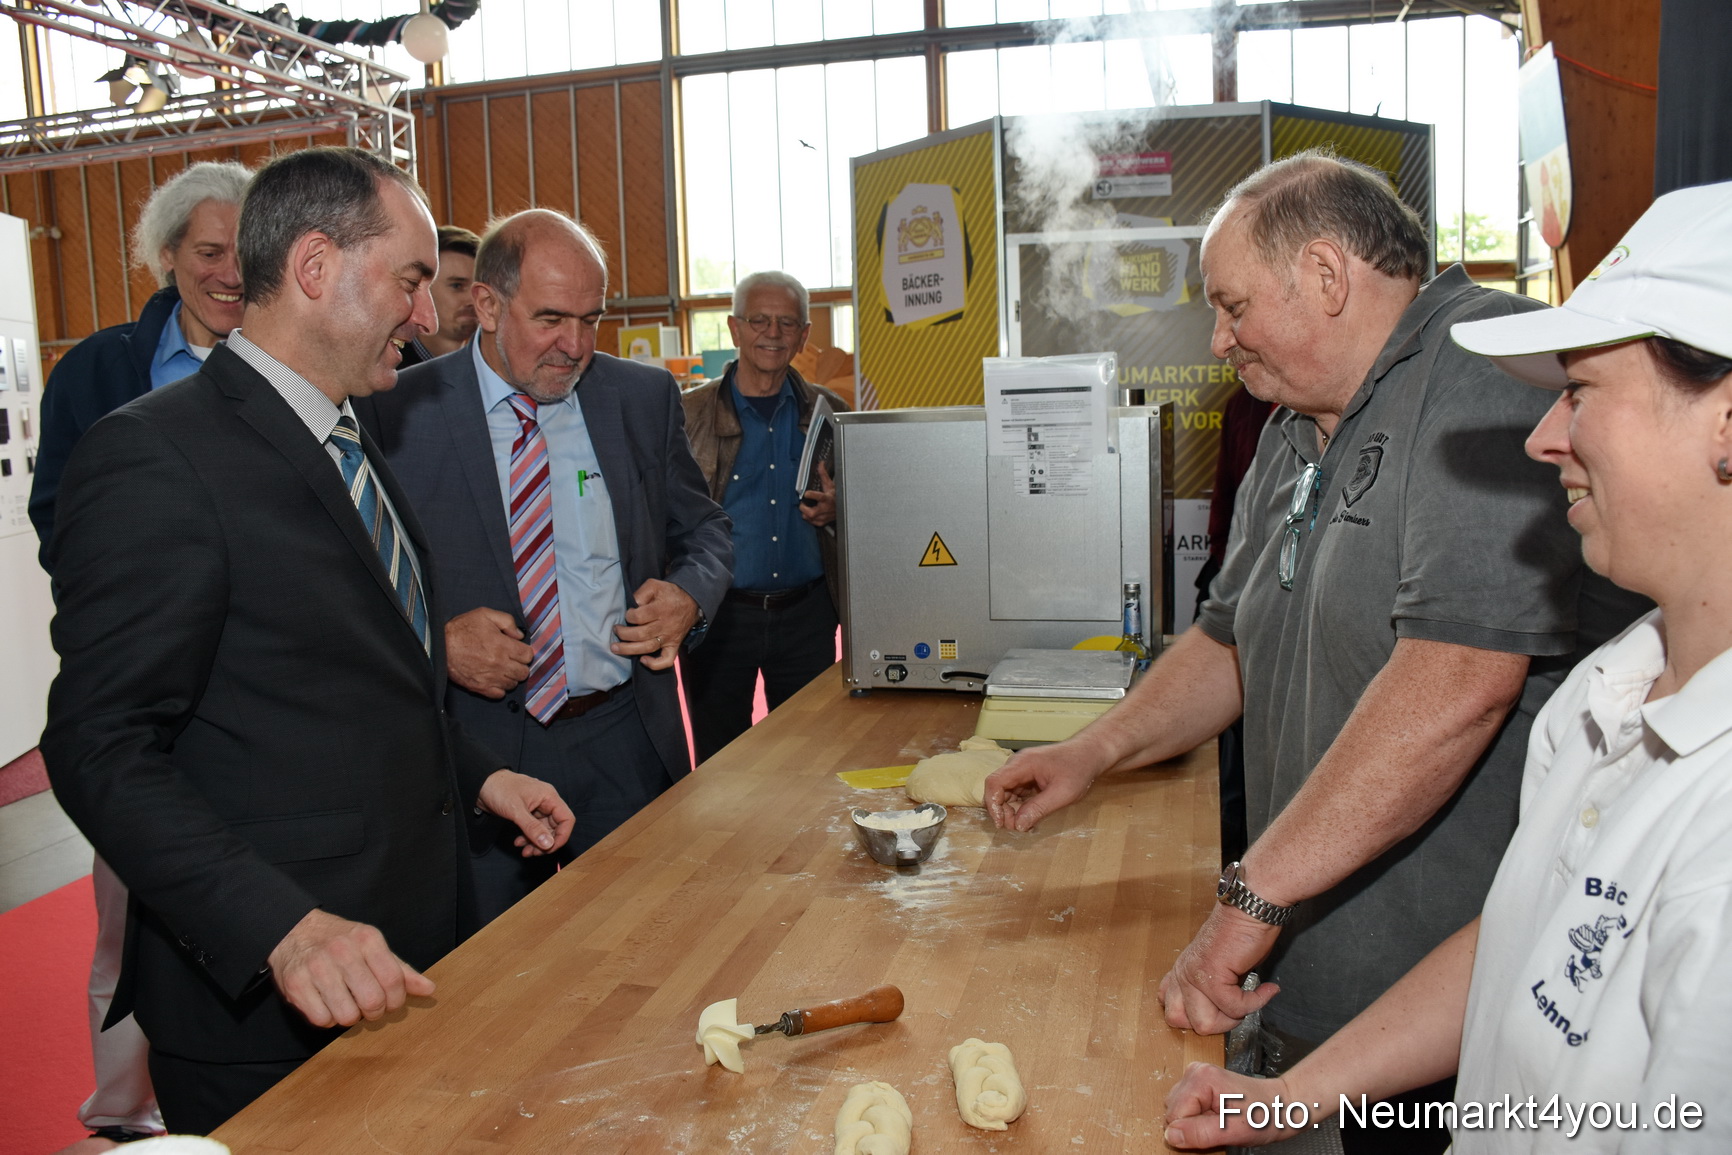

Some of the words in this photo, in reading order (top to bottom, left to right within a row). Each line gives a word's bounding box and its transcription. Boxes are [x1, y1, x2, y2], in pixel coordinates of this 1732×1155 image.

[901, 273, 944, 291] BÄCKER-
[1119, 277, 1161, 293] WERK
[904, 290, 943, 308] INNUNG
[1179, 411, 1223, 430] VOR
